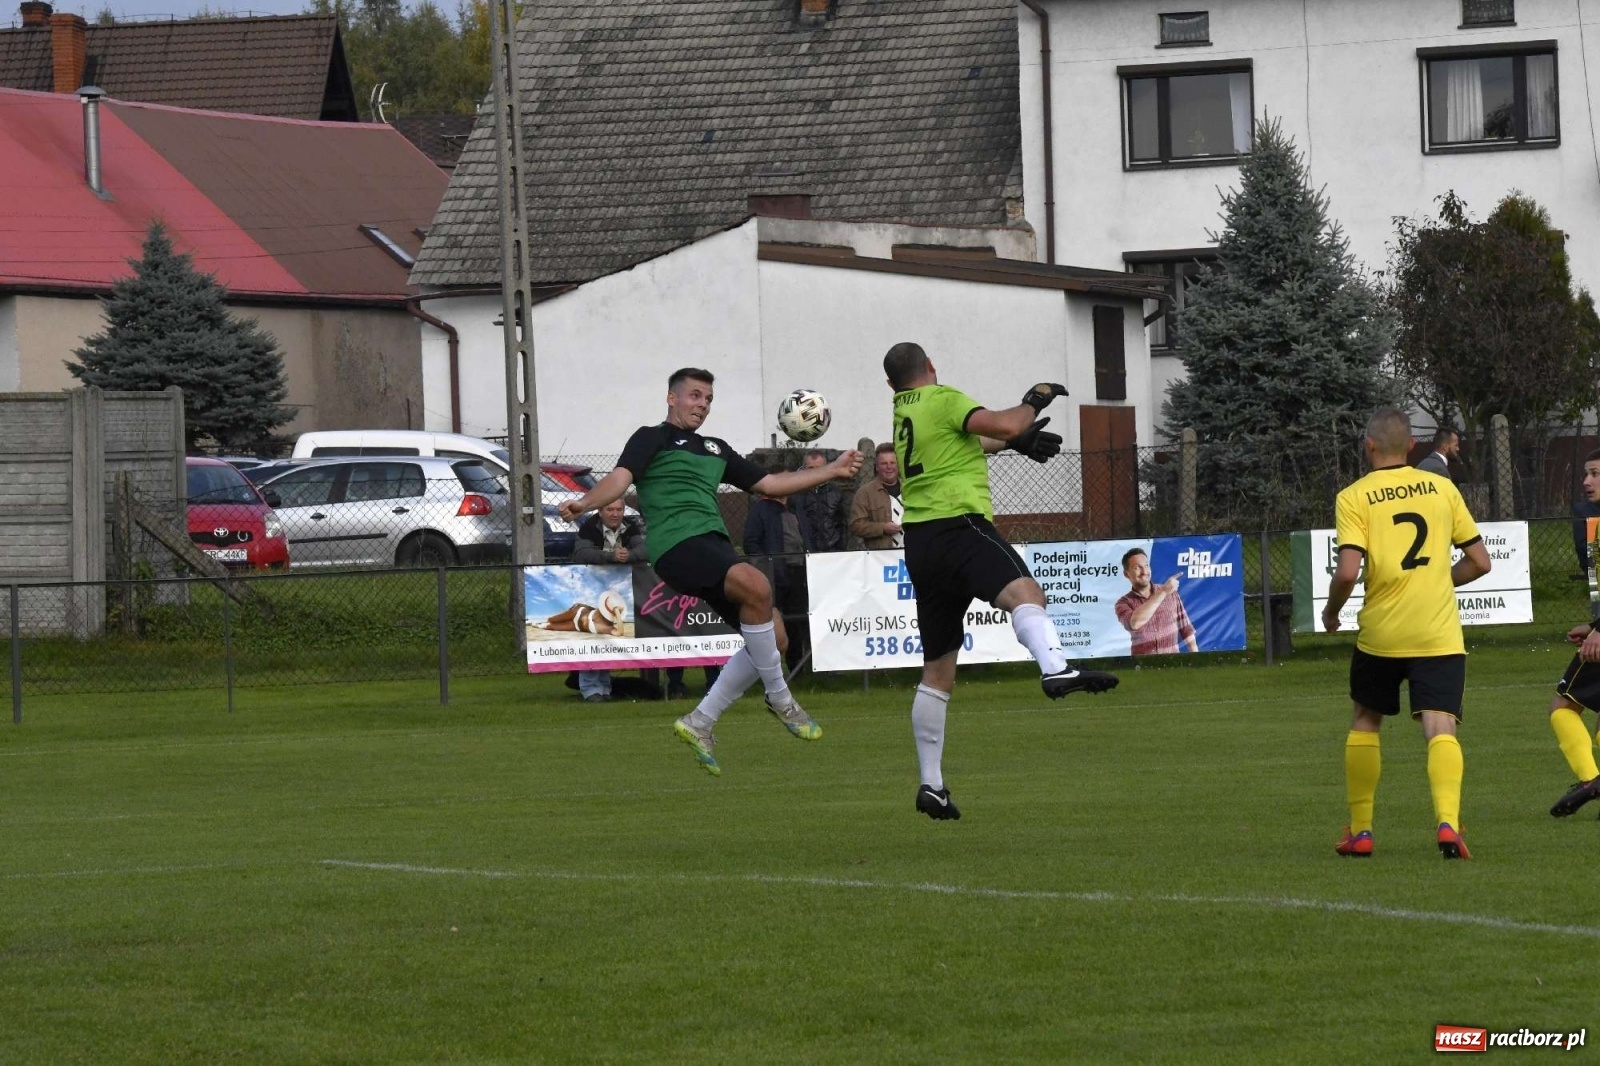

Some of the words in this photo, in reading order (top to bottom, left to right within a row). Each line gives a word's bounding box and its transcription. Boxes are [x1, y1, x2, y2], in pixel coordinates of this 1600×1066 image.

[899, 417, 924, 478] 2
[1366, 481, 1438, 505] LUBOMIA
[1392, 512, 1431, 571] 2
[1484, 535, 1506, 546] lnia
[1033, 551, 1087, 564] Podejmij
[1177, 547, 1211, 566] eko
[1034, 566, 1071, 578] dobrą
[1073, 563, 1119, 577] decyzję
[1188, 563, 1233, 578] okna
[1042, 580, 1081, 592] pracuj
[1046, 594, 1098, 604] Eko-Okna
[1458, 597, 1506, 610] KARNIA
[1066, 618, 1080, 626] 330
[1460, 611, 1490, 620] ubomia
[828, 617, 871, 636] Wyślij
[875, 616, 906, 631] SMS
[967, 611, 1008, 626] PRACA
[578, 645, 589, 655] ul.
[590, 643, 640, 655] Mickiewicza
[641, 643, 652, 653] 1a
[667, 642, 691, 654] piętro
[701, 641, 714, 651] tel.
[715, 640, 731, 650] 603
[733, 639, 746, 650] 70
[865, 636, 898, 656] 538
[902, 635, 924, 655] 62
